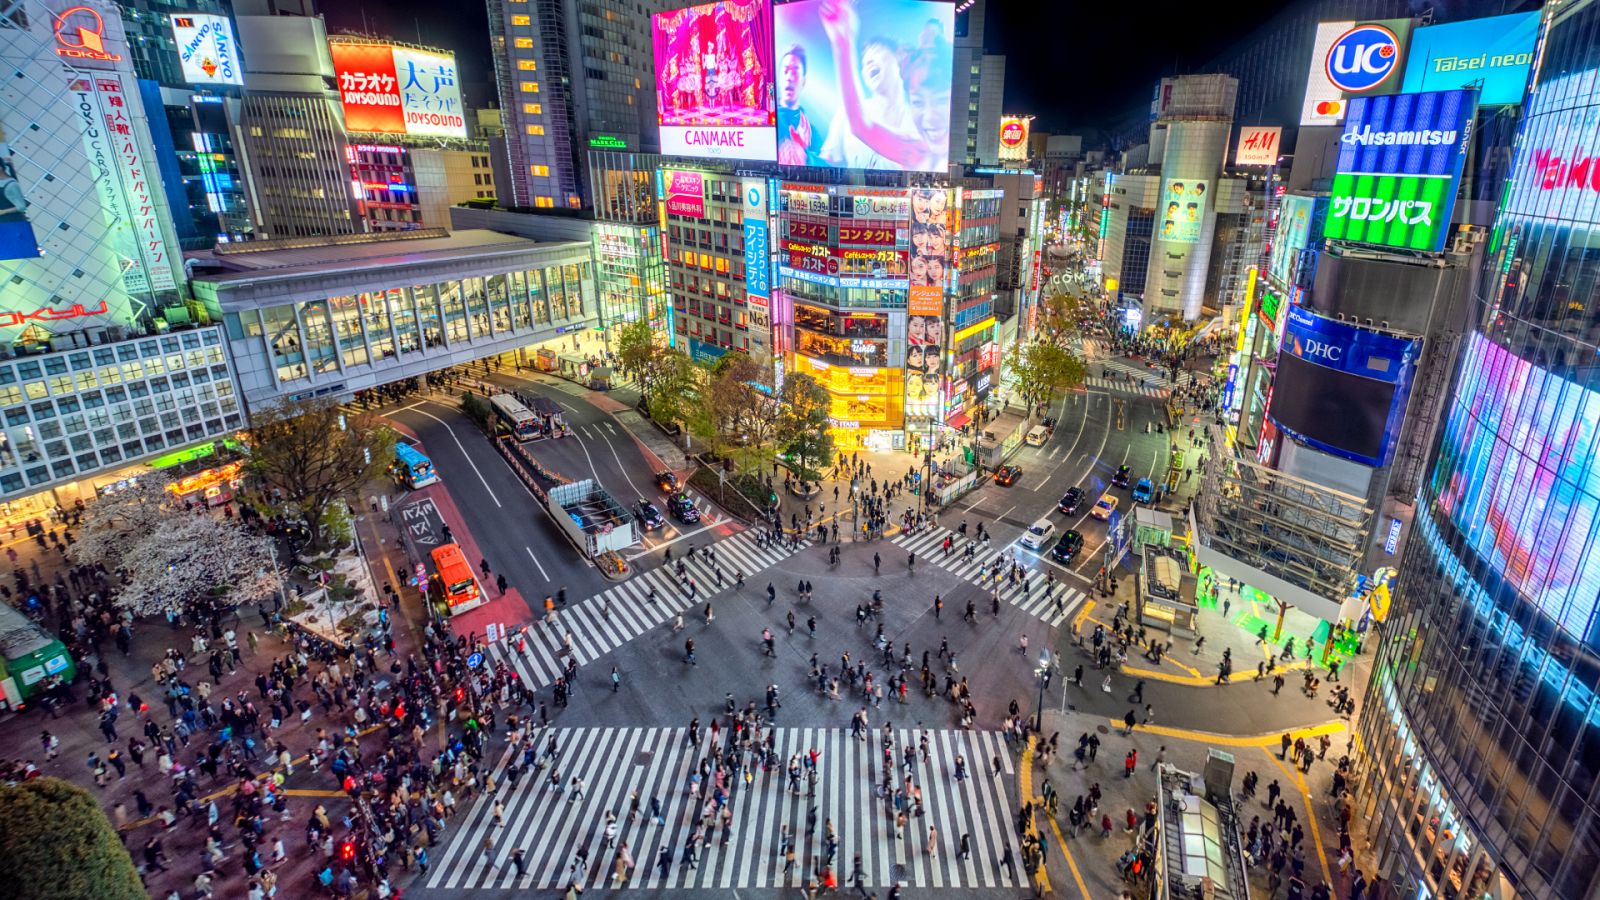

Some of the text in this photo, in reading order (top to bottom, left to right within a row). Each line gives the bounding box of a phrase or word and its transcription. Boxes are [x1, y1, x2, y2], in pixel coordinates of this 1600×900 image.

[182, 23, 210, 62] SANKYO
[212, 21, 232, 78] SANKYO
[55, 47, 122, 61] TOKYU
[1334, 43, 1391, 74] UC
[1433, 53, 1487, 73] Taisei
[341, 71, 395, 92] カラオケ
[399, 60, 455, 95] 大声
[344, 91, 400, 106] JOYSOUND
[406, 111, 463, 128] JOYSOUND
[685, 130, 744, 147] CANMAKE
[1243, 132, 1276, 150] H&M
[1341, 124, 1457, 146] Hisamitsu
[1333, 196, 1432, 226] サロンパス
[840, 229, 894, 242] コンタクト
[746, 225, 757, 289] アイシティ
[757, 226, 766, 290] コンタクトの
[802, 256, 825, 272] ガスト
[877, 251, 902, 262] ガスト
[1304, 338, 1341, 366] DHC
